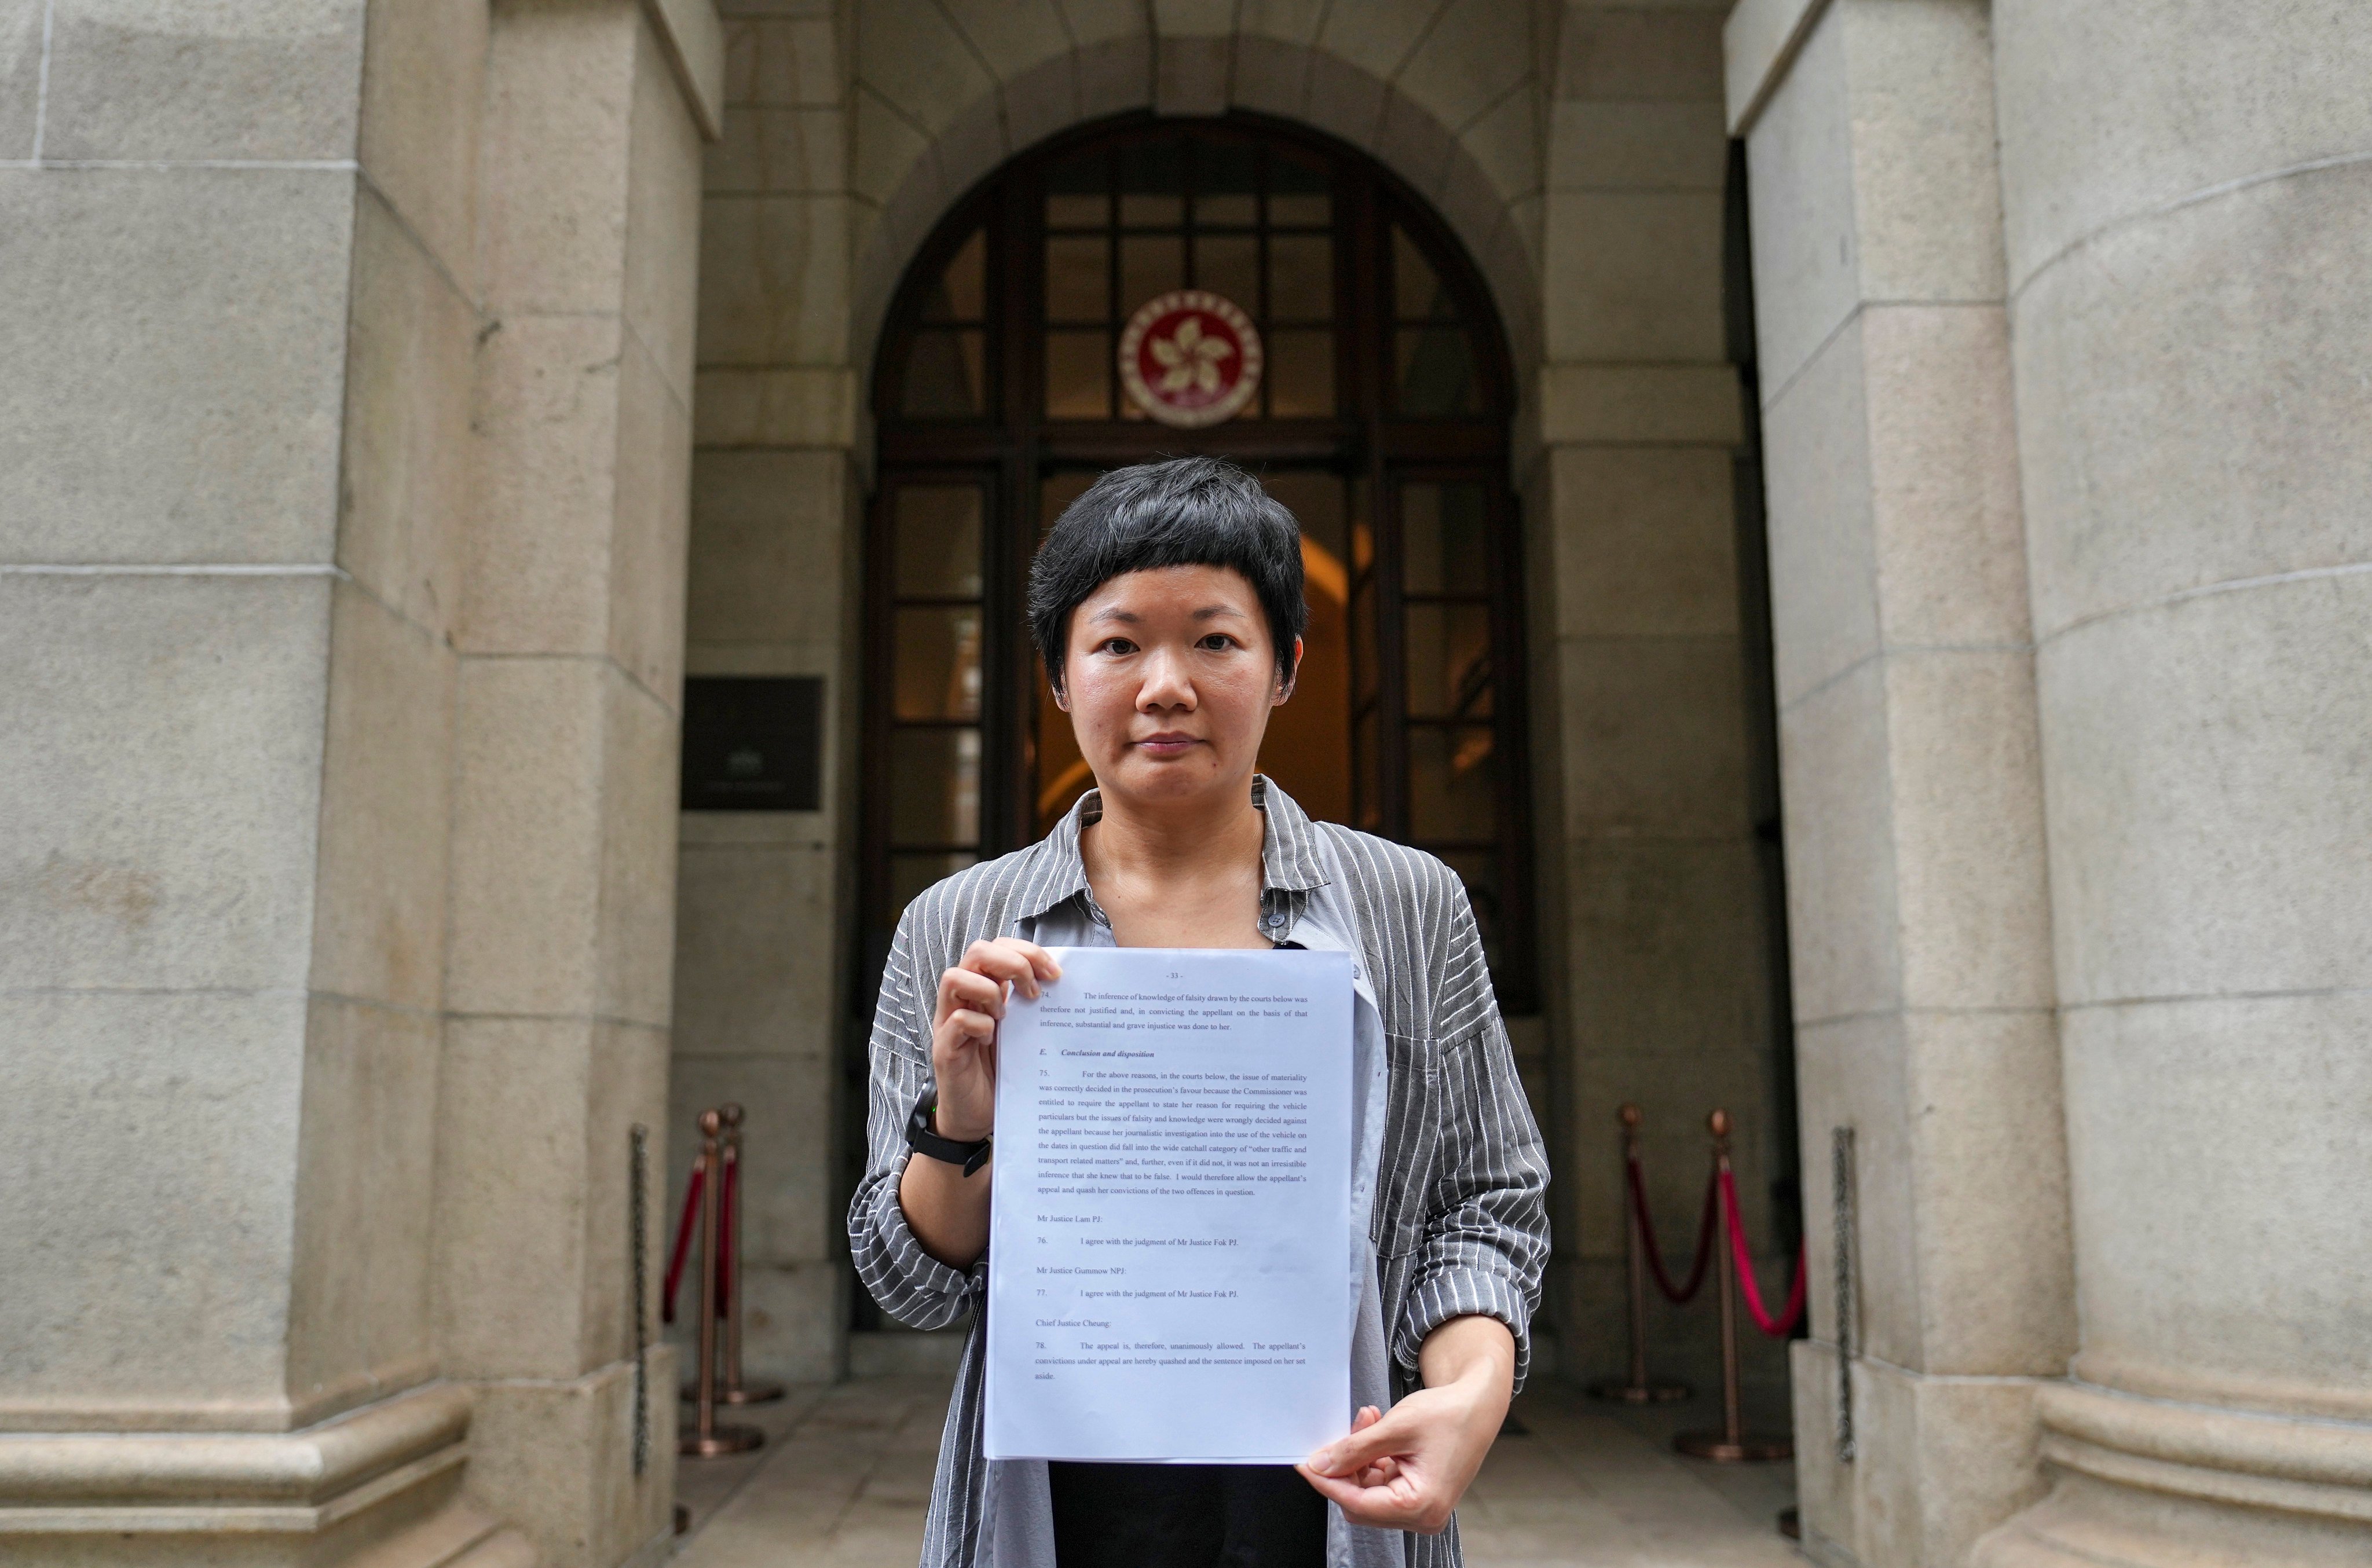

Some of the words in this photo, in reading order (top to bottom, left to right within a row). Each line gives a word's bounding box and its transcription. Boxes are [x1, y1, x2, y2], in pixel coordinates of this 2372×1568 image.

[1139, 993, 1176, 1002] knowledge
[1185, 994, 1206, 1003] falsity
[1230, 994, 1238, 1003] by
[1273, 995, 1293, 1003] below
[1041, 1020, 1074, 1028] inference,
[1148, 1022, 1176, 1031] injustice
[1192, 1022, 1209, 1030] done
[1061, 1049, 1101, 1057] Conclusion
[1117, 1049, 1155, 1059] disposition
[1205, 1072, 1228, 1081] below,
[1230, 1072, 1240, 1080] the
[1271, 1074, 1307, 1083] materiality
[1054, 1084, 1084, 1093] correctly
[1203, 1086, 1230, 1094] because
[1078, 1100, 1102, 1108] require
[1119, 1100, 1150, 1109] appellant
[1235, 1102, 1266, 1111] requiring
[1051, 1127, 1082, 1137] appellant
[1112, 1128, 1124, 1136] her
[1125, 1129, 1163, 1138] journalistic
[1165, 1130, 1208, 1139] investigation
[1038, 1185, 1060, 1195] appeal
[1076, 1186, 1096, 1195] quash
[1187, 1187, 1215, 1195] offences
[1225, 1188, 1256, 1197] question.
[1050, 1214, 1074, 1222] Justice
[1134, 1238, 1167, 1247] judgment
[1134, 1289, 1167, 1299] judgment
[1082, 1319, 1112, 1328] Cheung:
[1097, 1342, 1119, 1351] appeal
[1135, 1342, 1167, 1350] therefore,
[1170, 1342, 1214, 1351] unanimously
[1099, 1357, 1121, 1366] appeal
[1135, 1357, 1157, 1366] hereby
[1159, 1357, 1187, 1366] quashed
[1244, 1357, 1273, 1366] imposed
